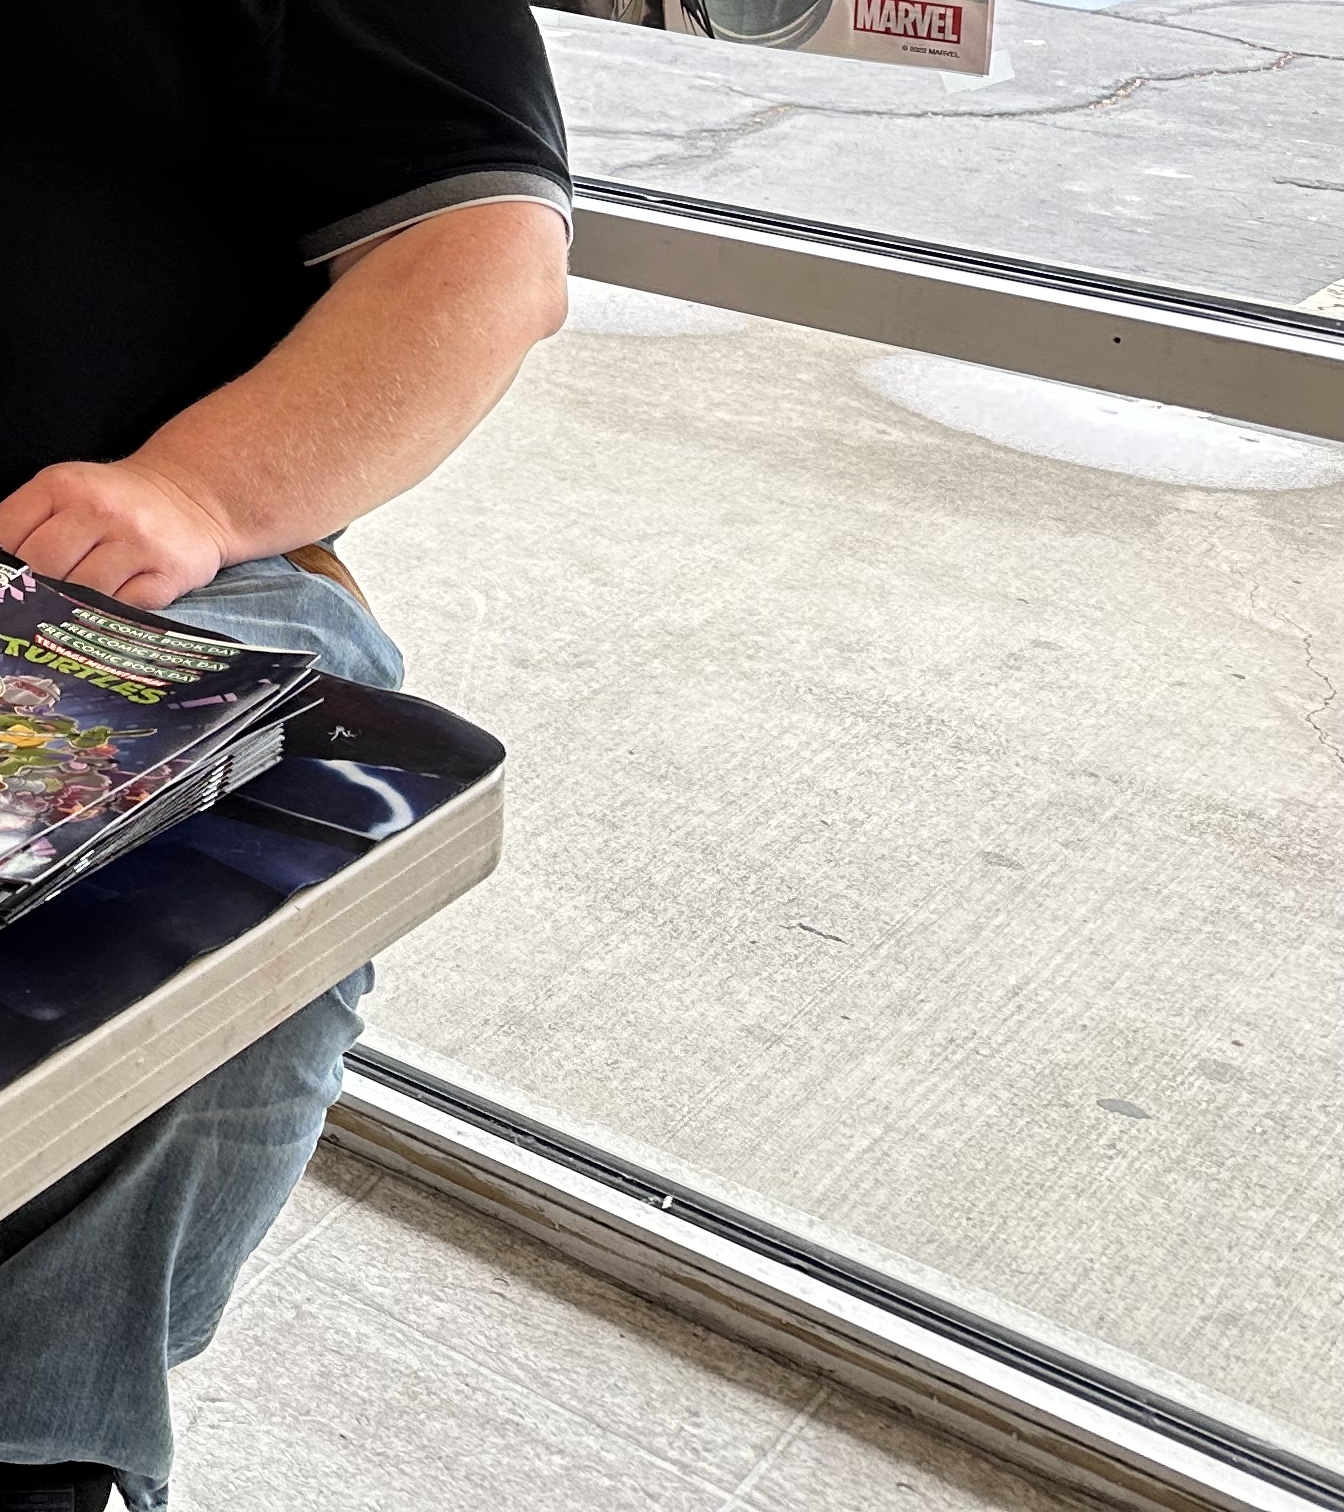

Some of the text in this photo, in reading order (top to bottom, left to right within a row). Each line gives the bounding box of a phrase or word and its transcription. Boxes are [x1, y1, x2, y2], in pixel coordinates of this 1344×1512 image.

[34, 635, 85, 662] TEENAGE
[37, 622, 196, 682] FREE COMIC BOOK DAY
[60, 622, 225, 672] FREE COMIC BOOK DAY
[72, 608, 236, 656] FREE COMIC BOOK DAY
